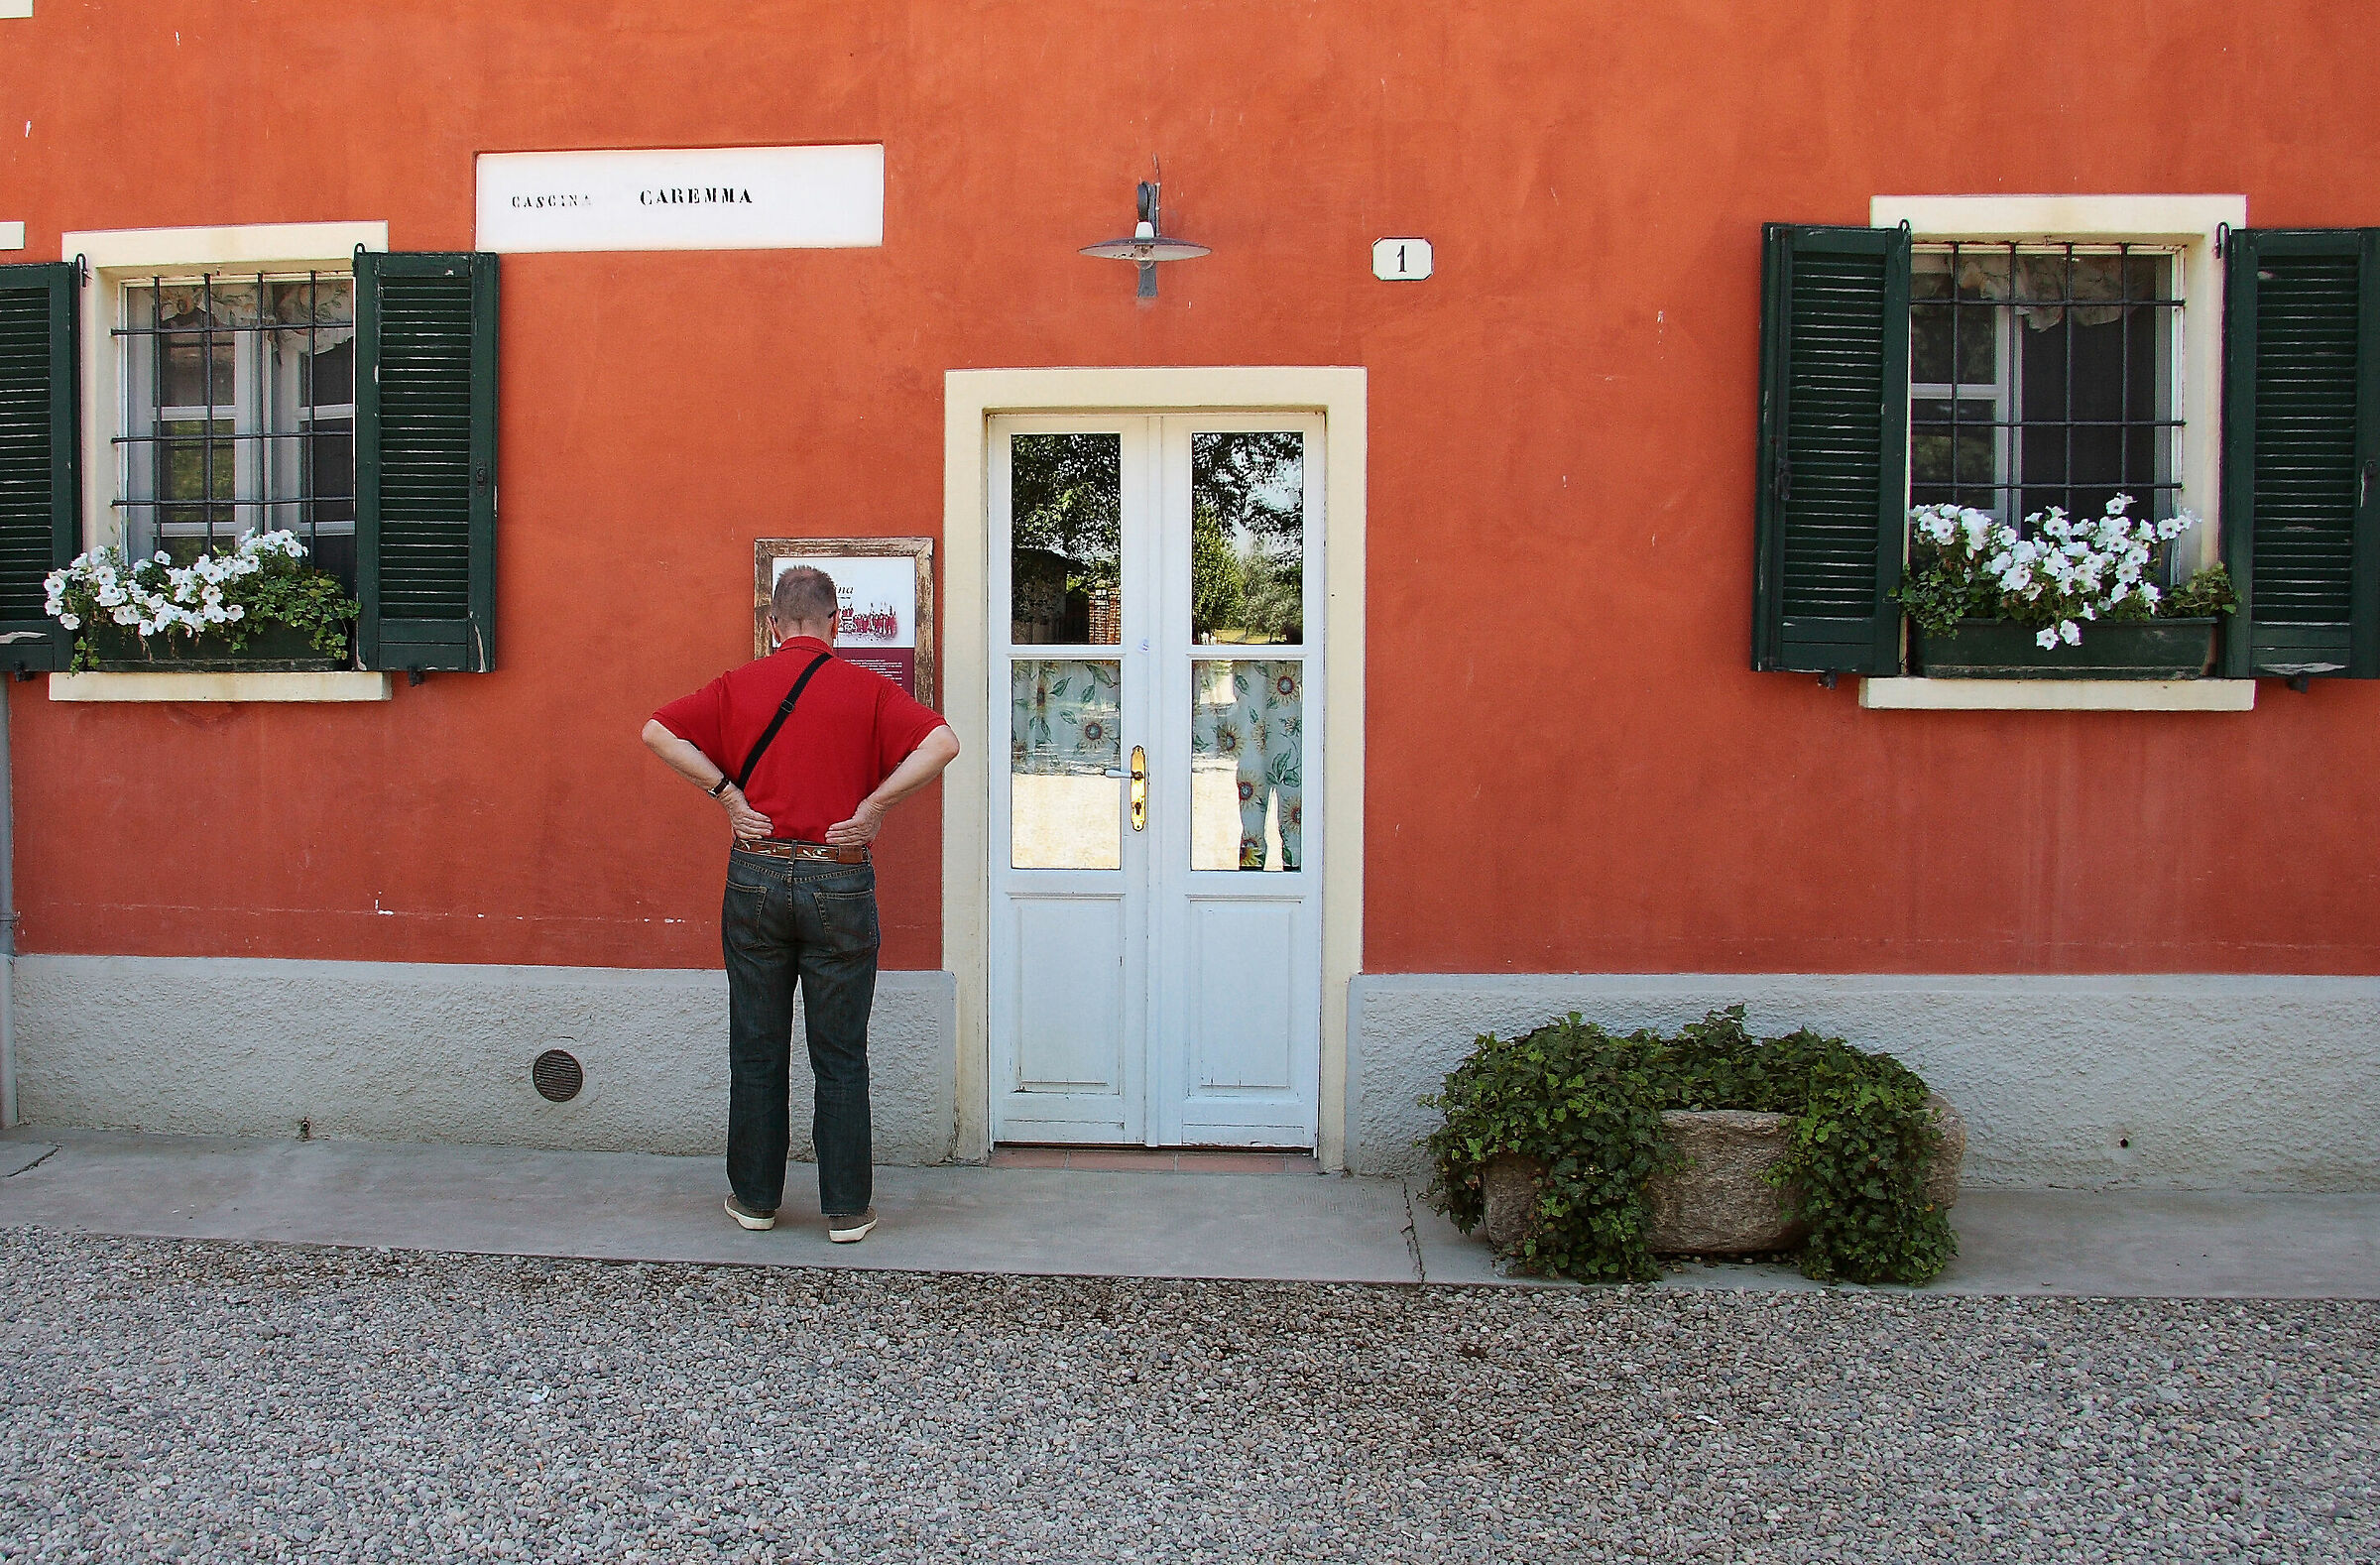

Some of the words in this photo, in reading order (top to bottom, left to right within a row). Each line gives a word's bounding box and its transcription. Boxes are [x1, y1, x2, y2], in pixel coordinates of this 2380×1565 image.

[640, 187, 753, 206] CAREMMA
[1396, 244, 1408, 273] 1
[835, 584, 854, 595] na
